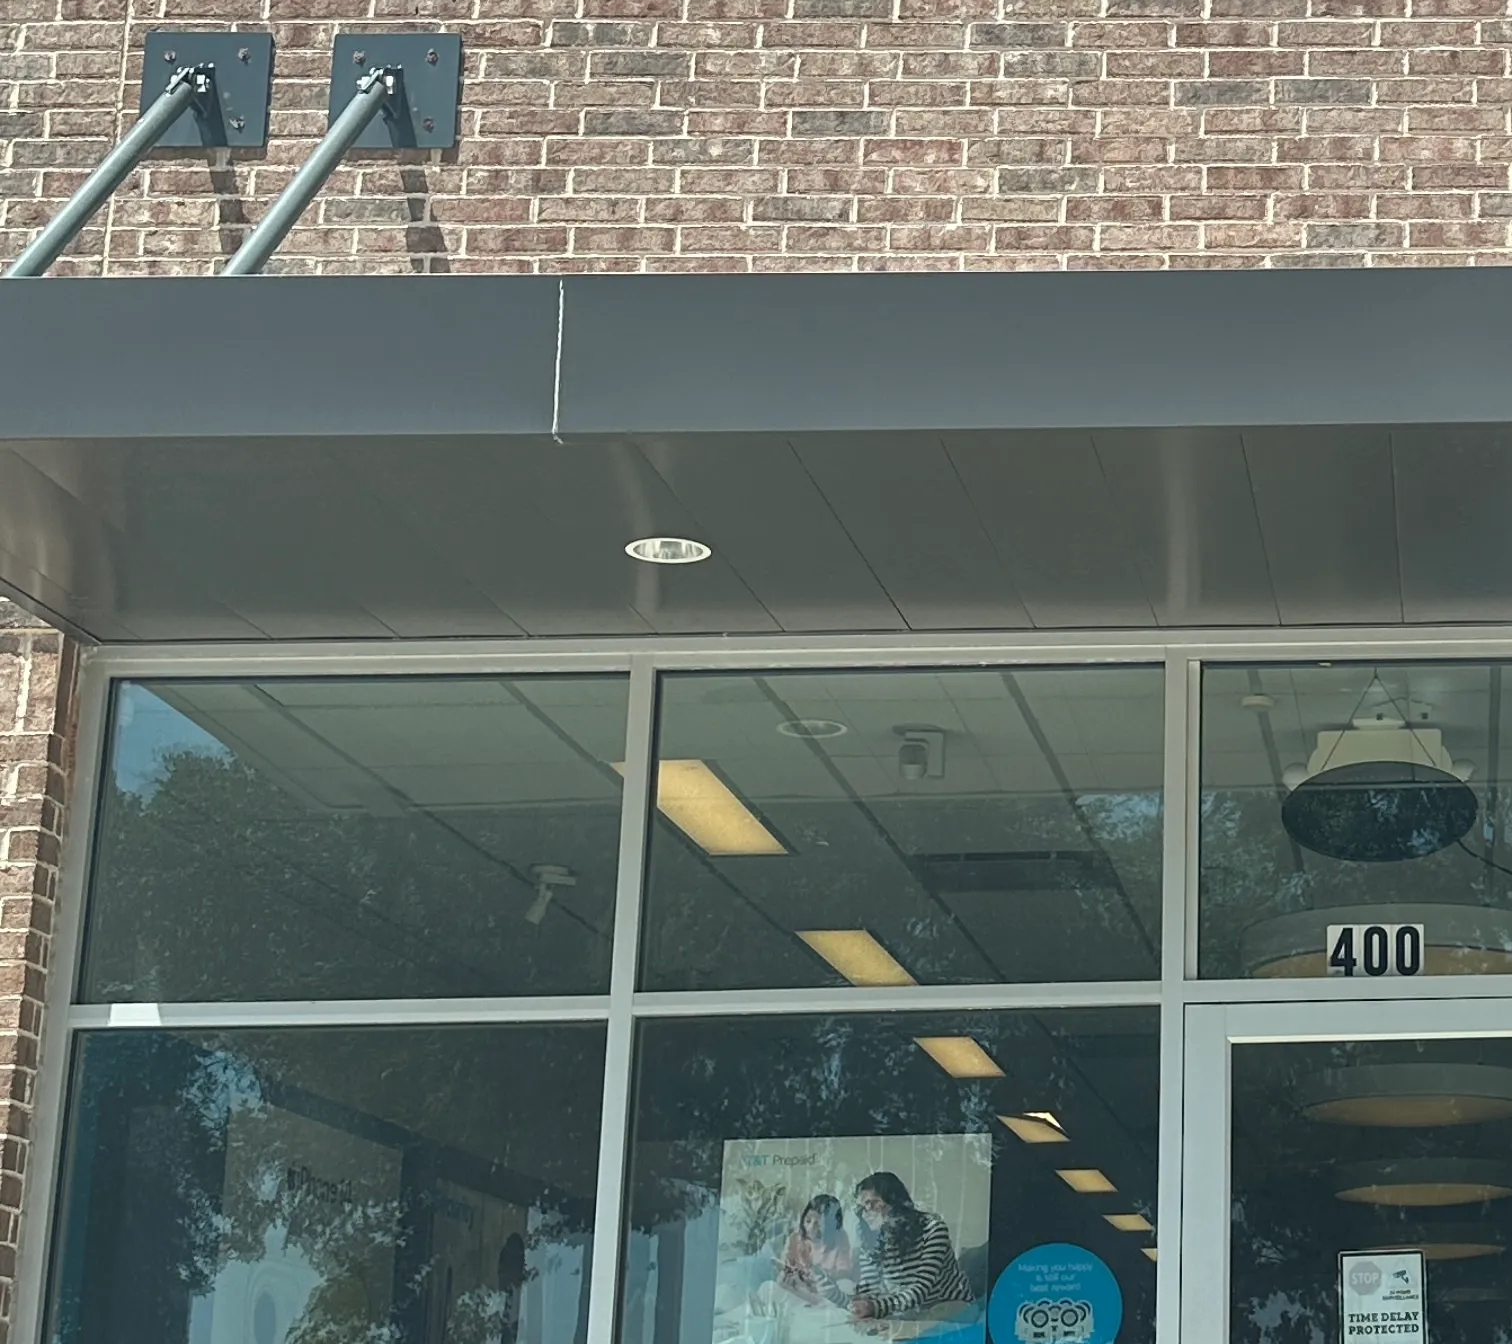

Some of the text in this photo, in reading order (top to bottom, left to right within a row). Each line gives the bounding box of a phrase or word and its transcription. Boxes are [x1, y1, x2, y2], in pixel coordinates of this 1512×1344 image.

[1330, 926, 1420, 976] 400
[1352, 1272, 1380, 1285] STOP
[1348, 1312, 1419, 1324] TIME DELAY
[1348, 1323, 1419, 1335] PROTECTED
